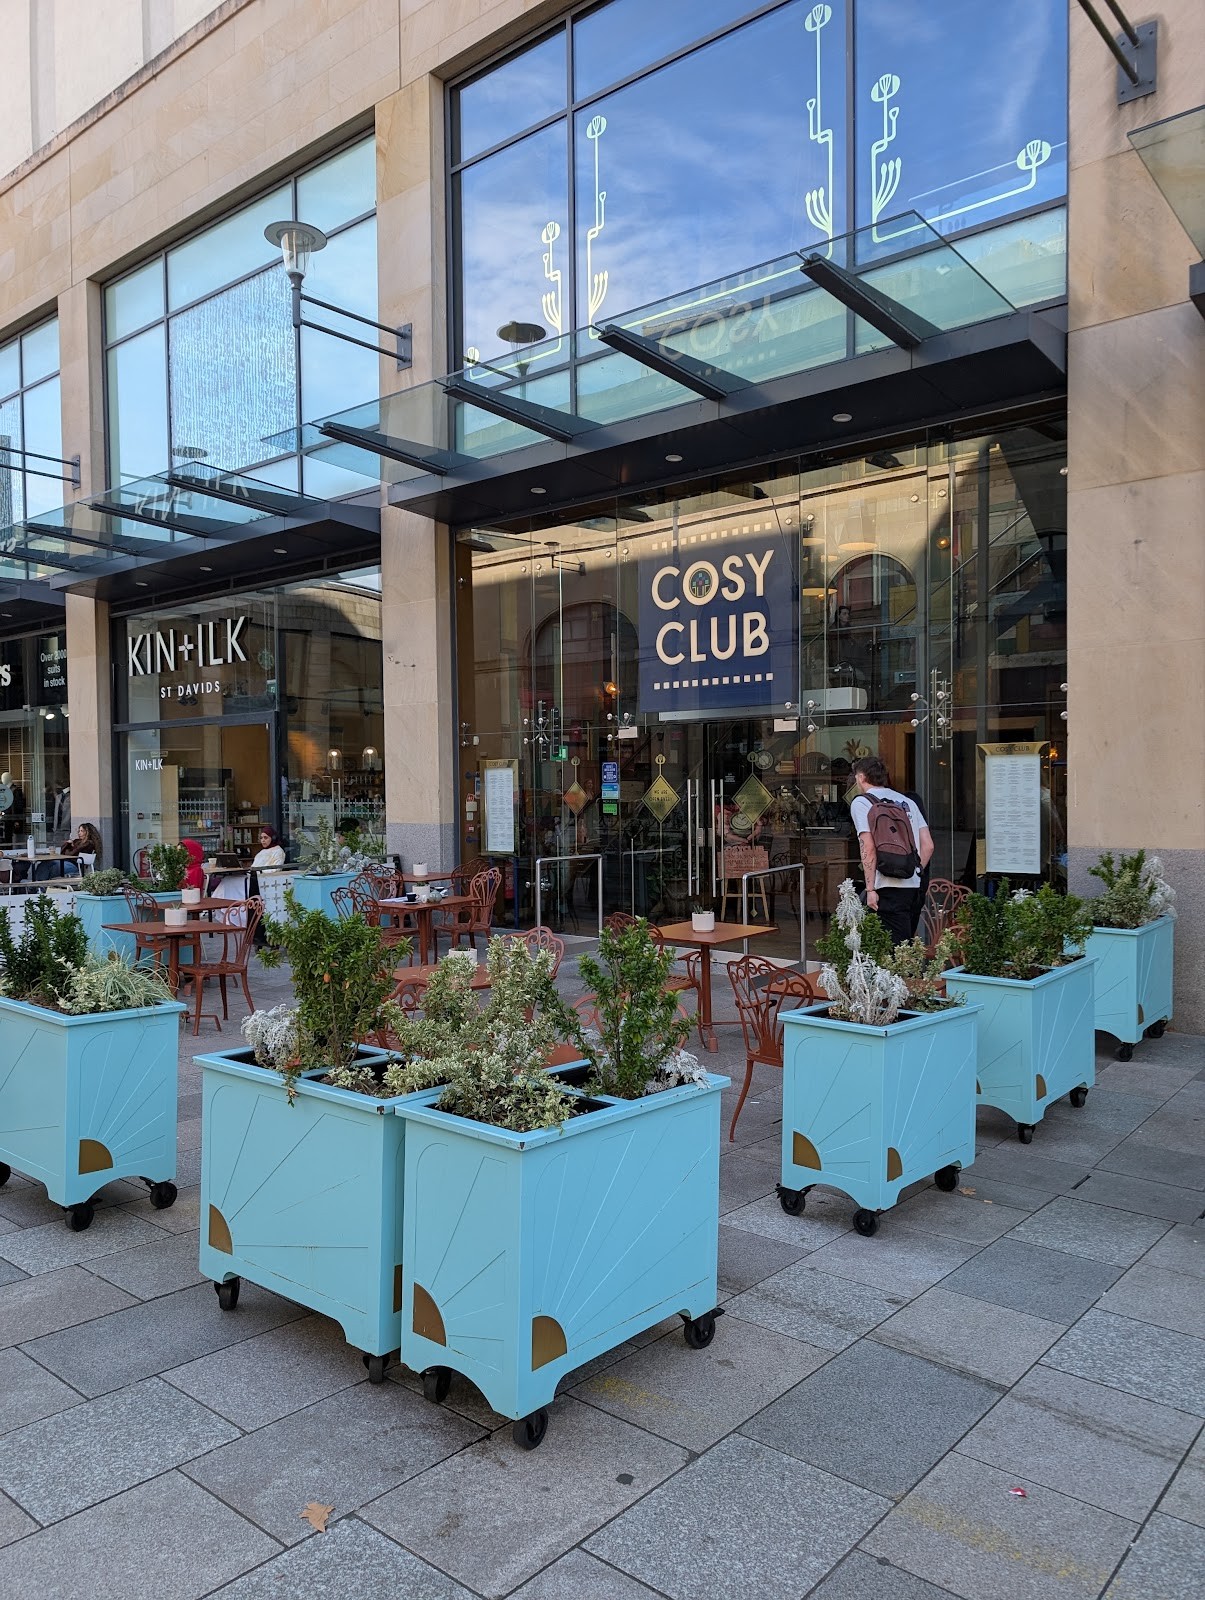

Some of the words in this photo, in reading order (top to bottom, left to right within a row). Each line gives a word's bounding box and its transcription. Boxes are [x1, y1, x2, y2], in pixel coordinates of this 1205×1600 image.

[651, 549, 775, 611] COSY
[128, 615, 247, 677] KIN+ILK
[655, 611, 770, 666] CLUB
[40, 652, 54, 663] Over
[47, 663, 61, 675] suits
[43, 678, 50, 688] in
[50, 676, 66, 687] stock
[160, 686, 172, 698] ST
[178, 680, 221, 696] DAVIDS
[135, 758, 164, 771] KIN+ILK
